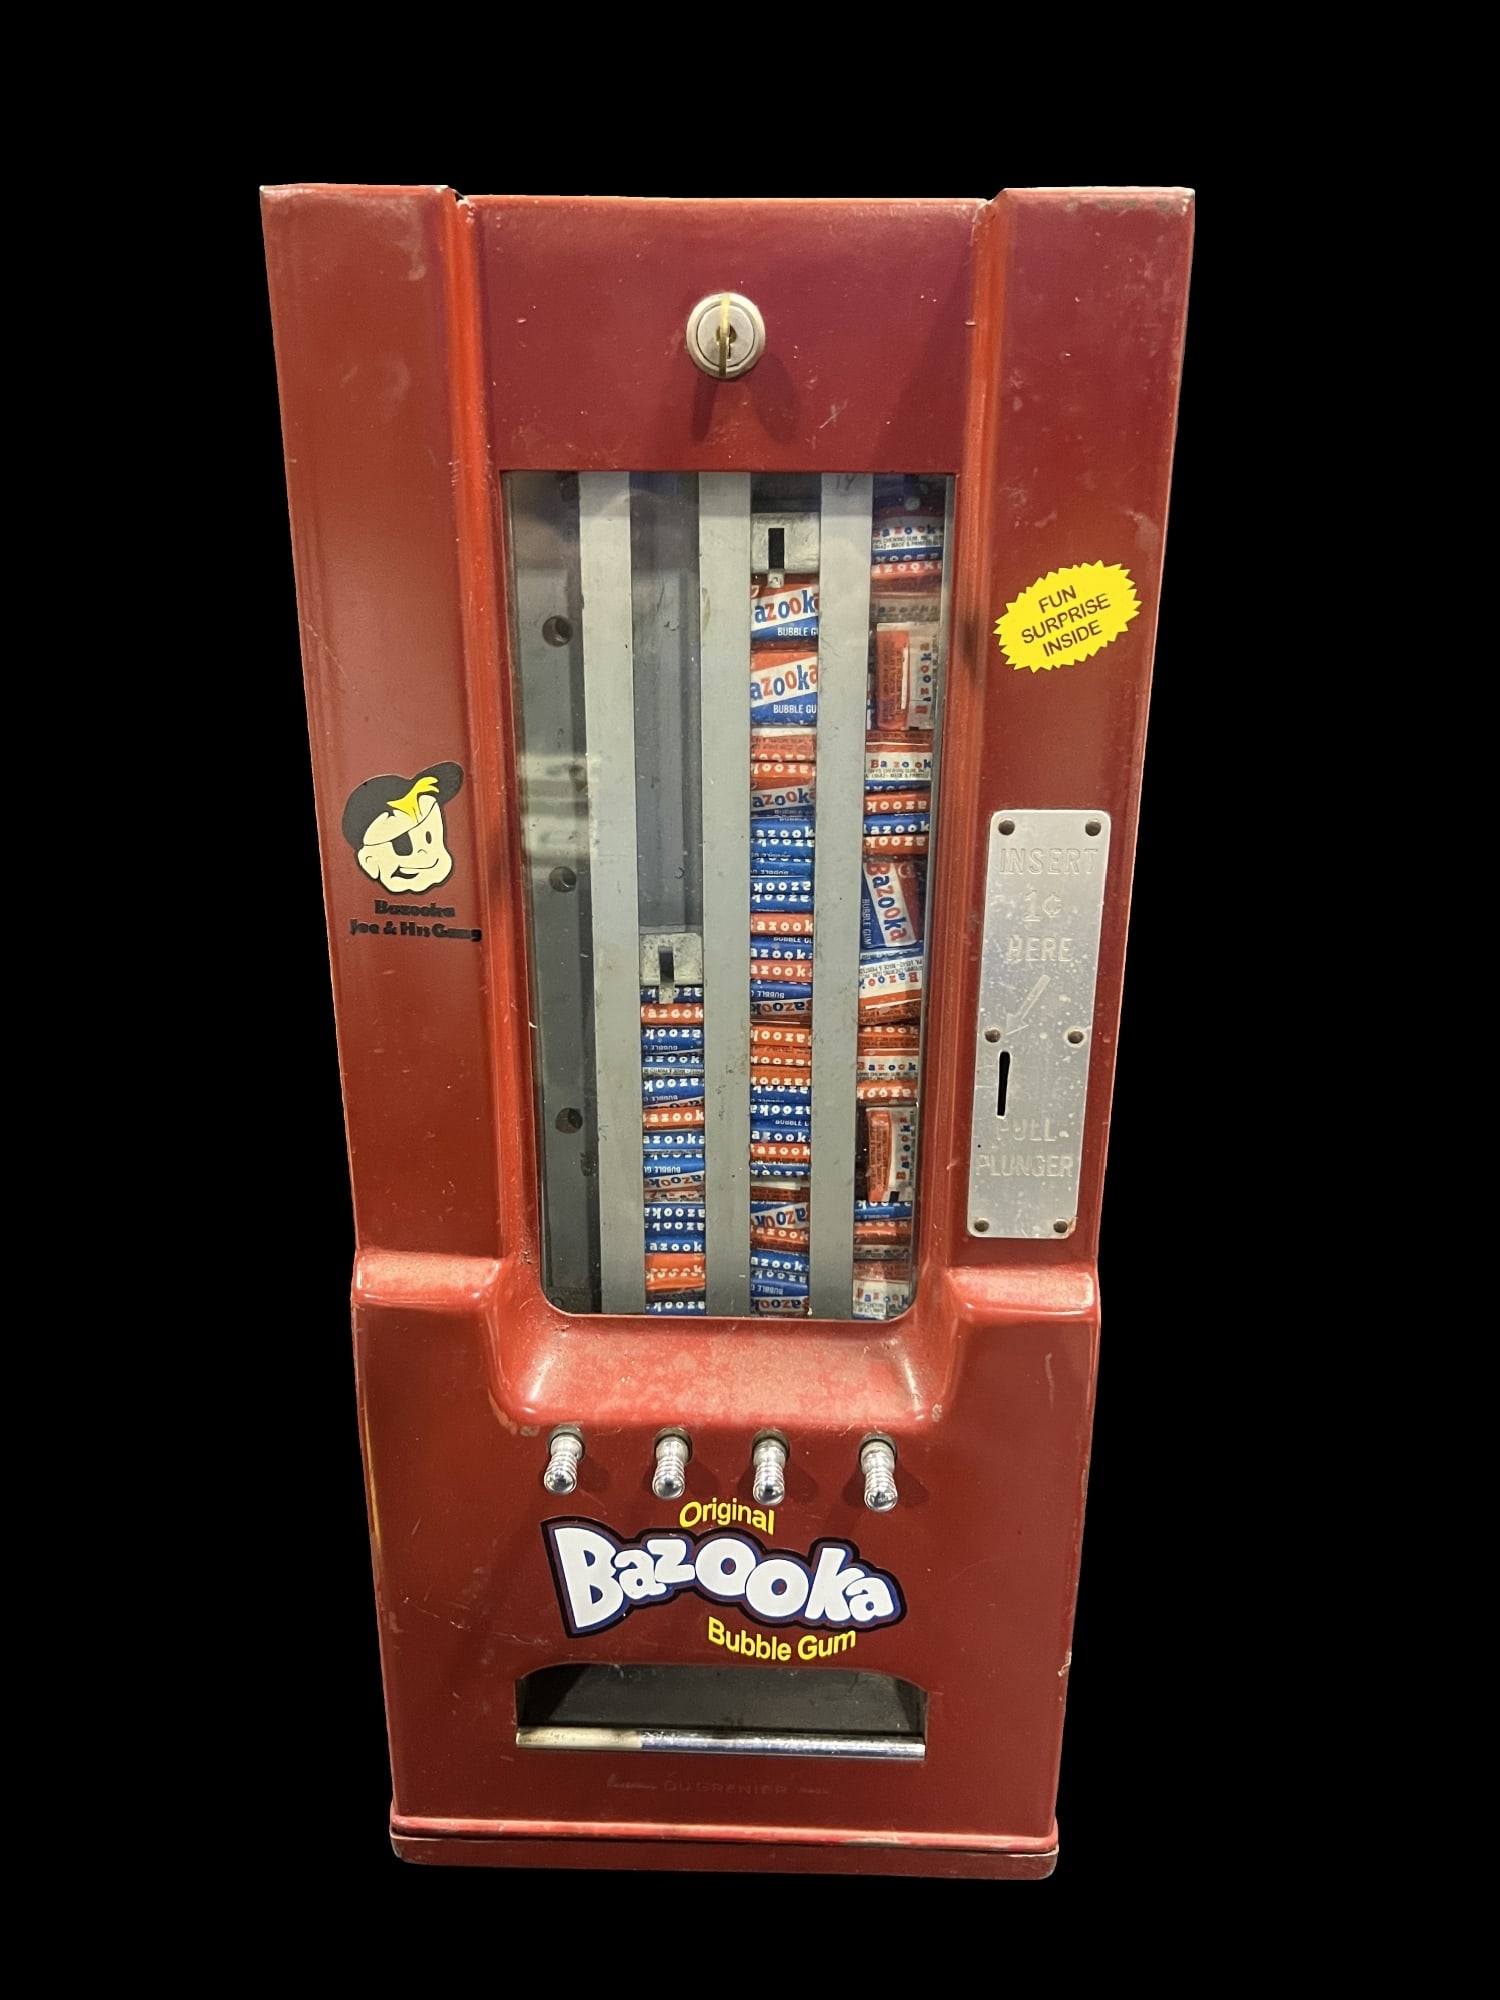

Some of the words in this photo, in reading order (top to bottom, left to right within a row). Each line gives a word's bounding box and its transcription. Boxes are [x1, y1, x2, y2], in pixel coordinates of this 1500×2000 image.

[1038, 585, 1077, 613] FUN
[754, 590, 819, 623] azook
[1021, 593, 1111, 644] SURPRISE
[777, 627, 808, 637] BUBBLE
[811, 627, 818, 636] G
[1043, 620, 1103, 657] INSIDE
[750, 664, 817, 700] azooka
[773, 704, 804, 714] BUBBLE
[806, 704, 817, 714] GU
[870, 758, 932, 769] Bazook
[866, 801, 927, 812] azook
[755, 826, 815, 838] azook
[866, 836, 926, 848] azook
[999, 848, 1099, 875] INSERT
[754, 881, 811, 893] azook
[752, 894, 809, 903] azook
[866, 862, 907, 941] Bazooka
[383, 920, 397, 935] &
[1007, 935, 1073, 962] HERE
[859, 972, 919, 989] Bazook
[646, 1029, 701, 1040] azook
[644, 1078, 704, 1092] azook
[856, 1088, 917, 1099] azook
[751, 1130, 811, 1142] azook
[995, 1118, 1056, 1141] PULL
[643, 1133, 704, 1144] azooka
[976, 1154, 1074, 1177] PLUNGER
[650, 1241, 702, 1251] azook
[755, 1270, 807, 1283] azook
[646, 1301, 705, 1312] azook
[679, 1497, 775, 1536] Original
[552, 1526, 895, 1629] Bazooka
[708, 1616, 791, 1662] Bubble
[797, 1630, 857, 1662] Gum
